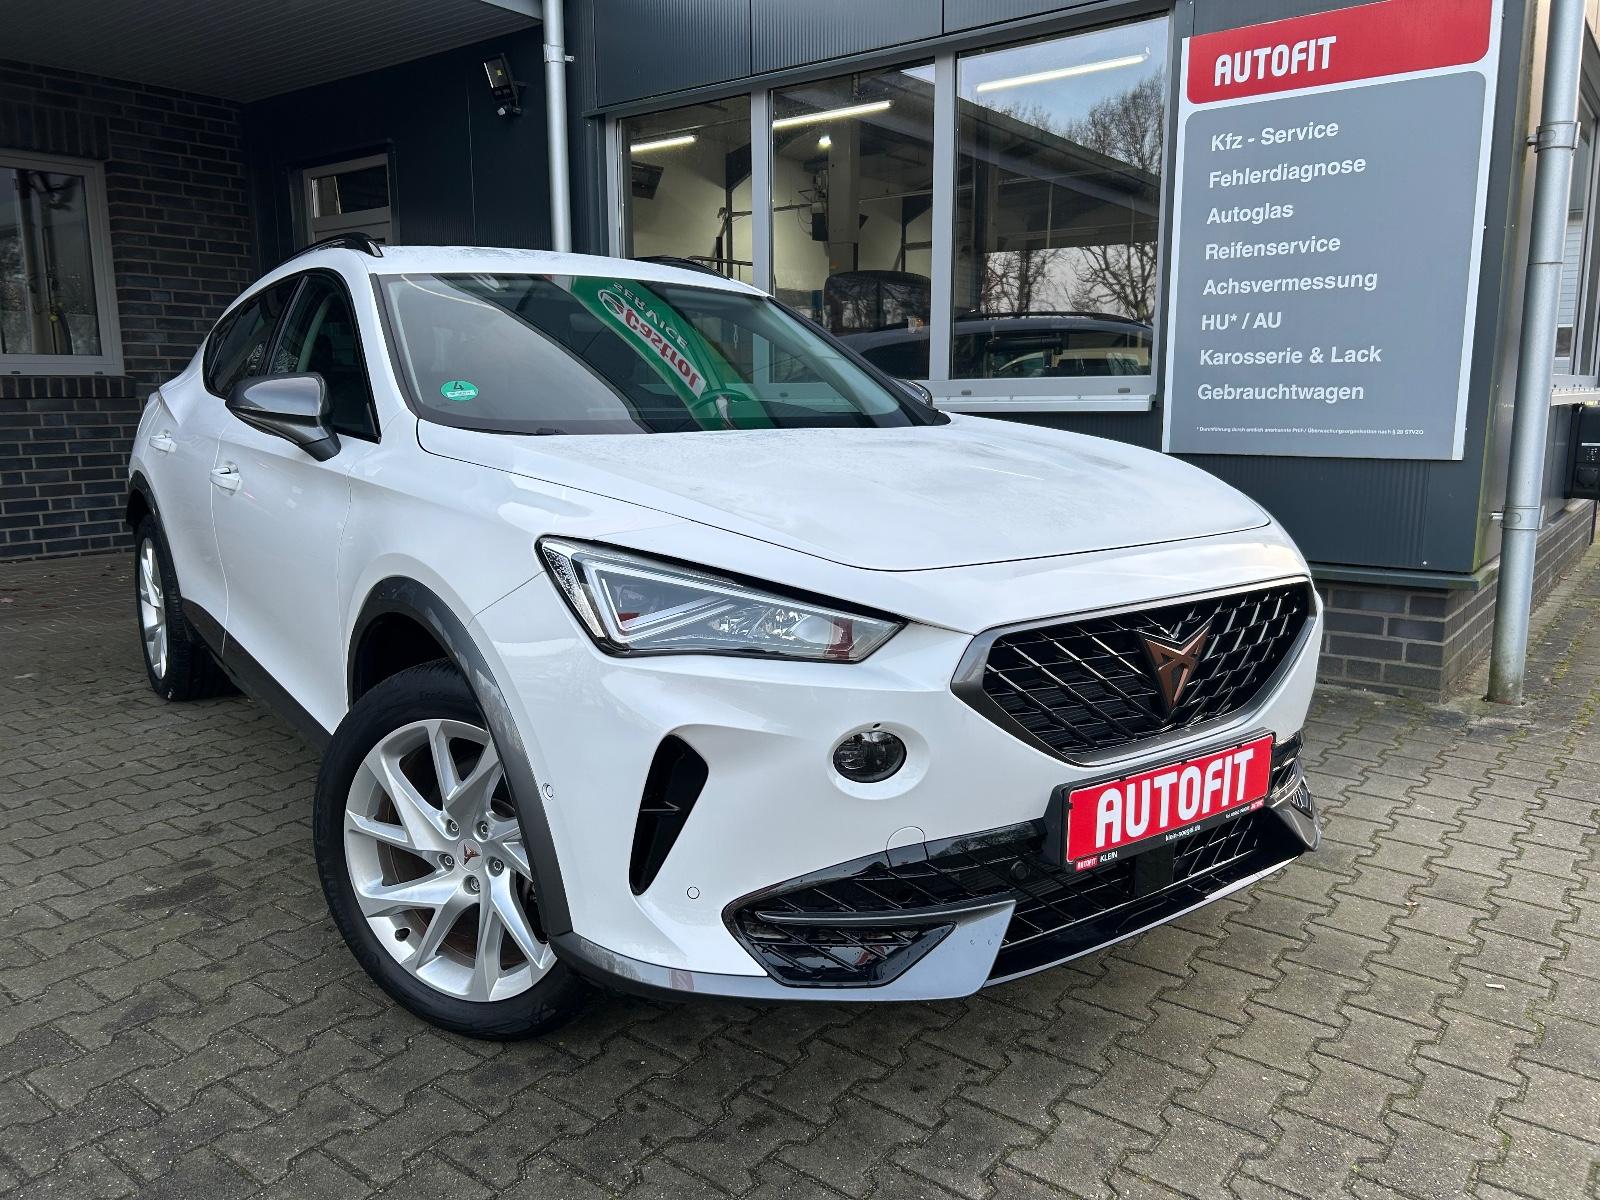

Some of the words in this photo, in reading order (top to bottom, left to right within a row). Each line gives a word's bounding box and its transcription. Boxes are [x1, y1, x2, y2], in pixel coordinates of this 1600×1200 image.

[1214, 36, 1337, 87] AUTOFIT
[1211, 133, 1242, 152] Kfz
[1260, 121, 1339, 145] Service
[1209, 157, 1367, 188] Fehlerdiagnose
[1206, 203, 1294, 225] Autoglas
[1205, 236, 1341, 260] Reifenservice
[1202, 272, 1378, 296] Achsvermessung
[1242, 313, 1251, 330] /
[1252, 311, 1282, 329] AU
[1199, 348, 1303, 366] Karosserie
[1309, 347, 1324, 364] &
[1330, 346, 1382, 363] Lack
[1197, 383, 1364, 404] Gebrauchtwagen
[1095, 748, 1253, 848] AUTOFIT
[1099, 850, 1118, 862] KLEIN
